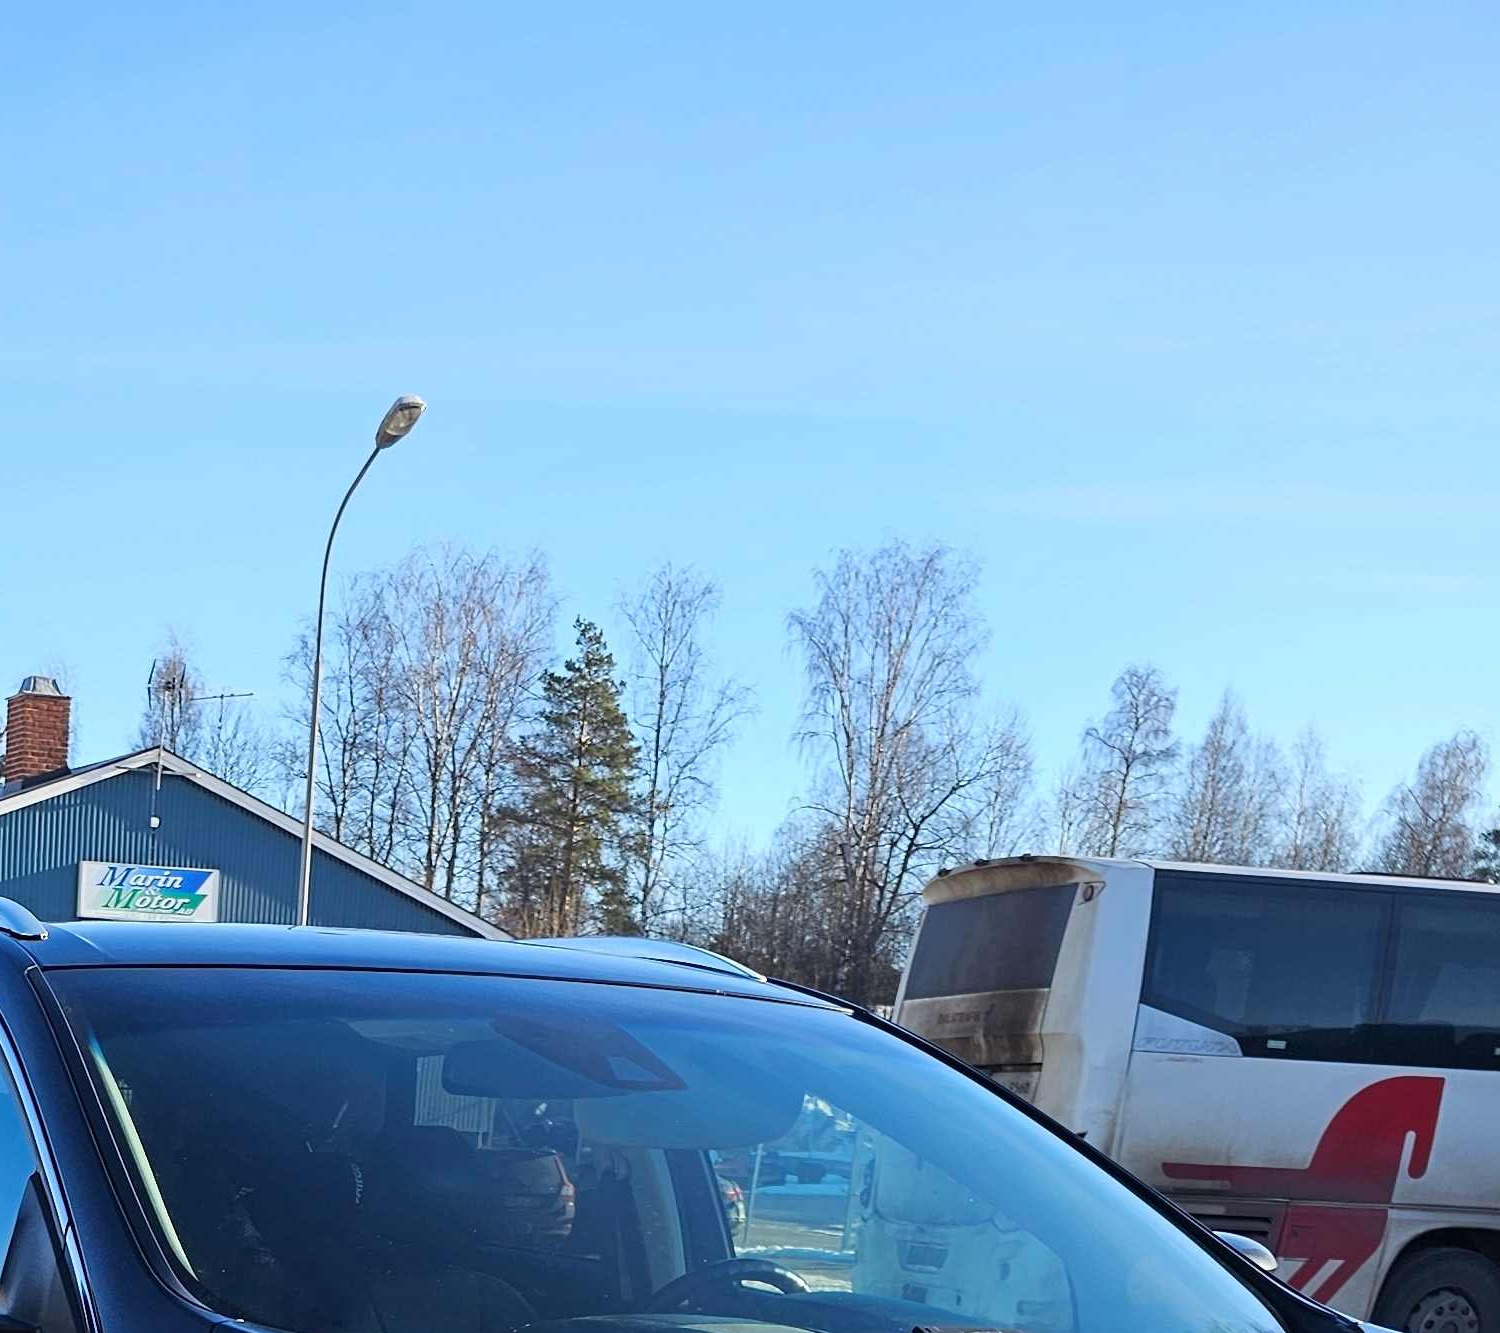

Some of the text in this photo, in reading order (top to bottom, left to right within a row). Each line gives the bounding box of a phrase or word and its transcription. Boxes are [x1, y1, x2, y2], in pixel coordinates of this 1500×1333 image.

[97, 866, 183, 889] Marin
[102, 887, 190, 911] Motor
[144, 886, 162, 897] &
